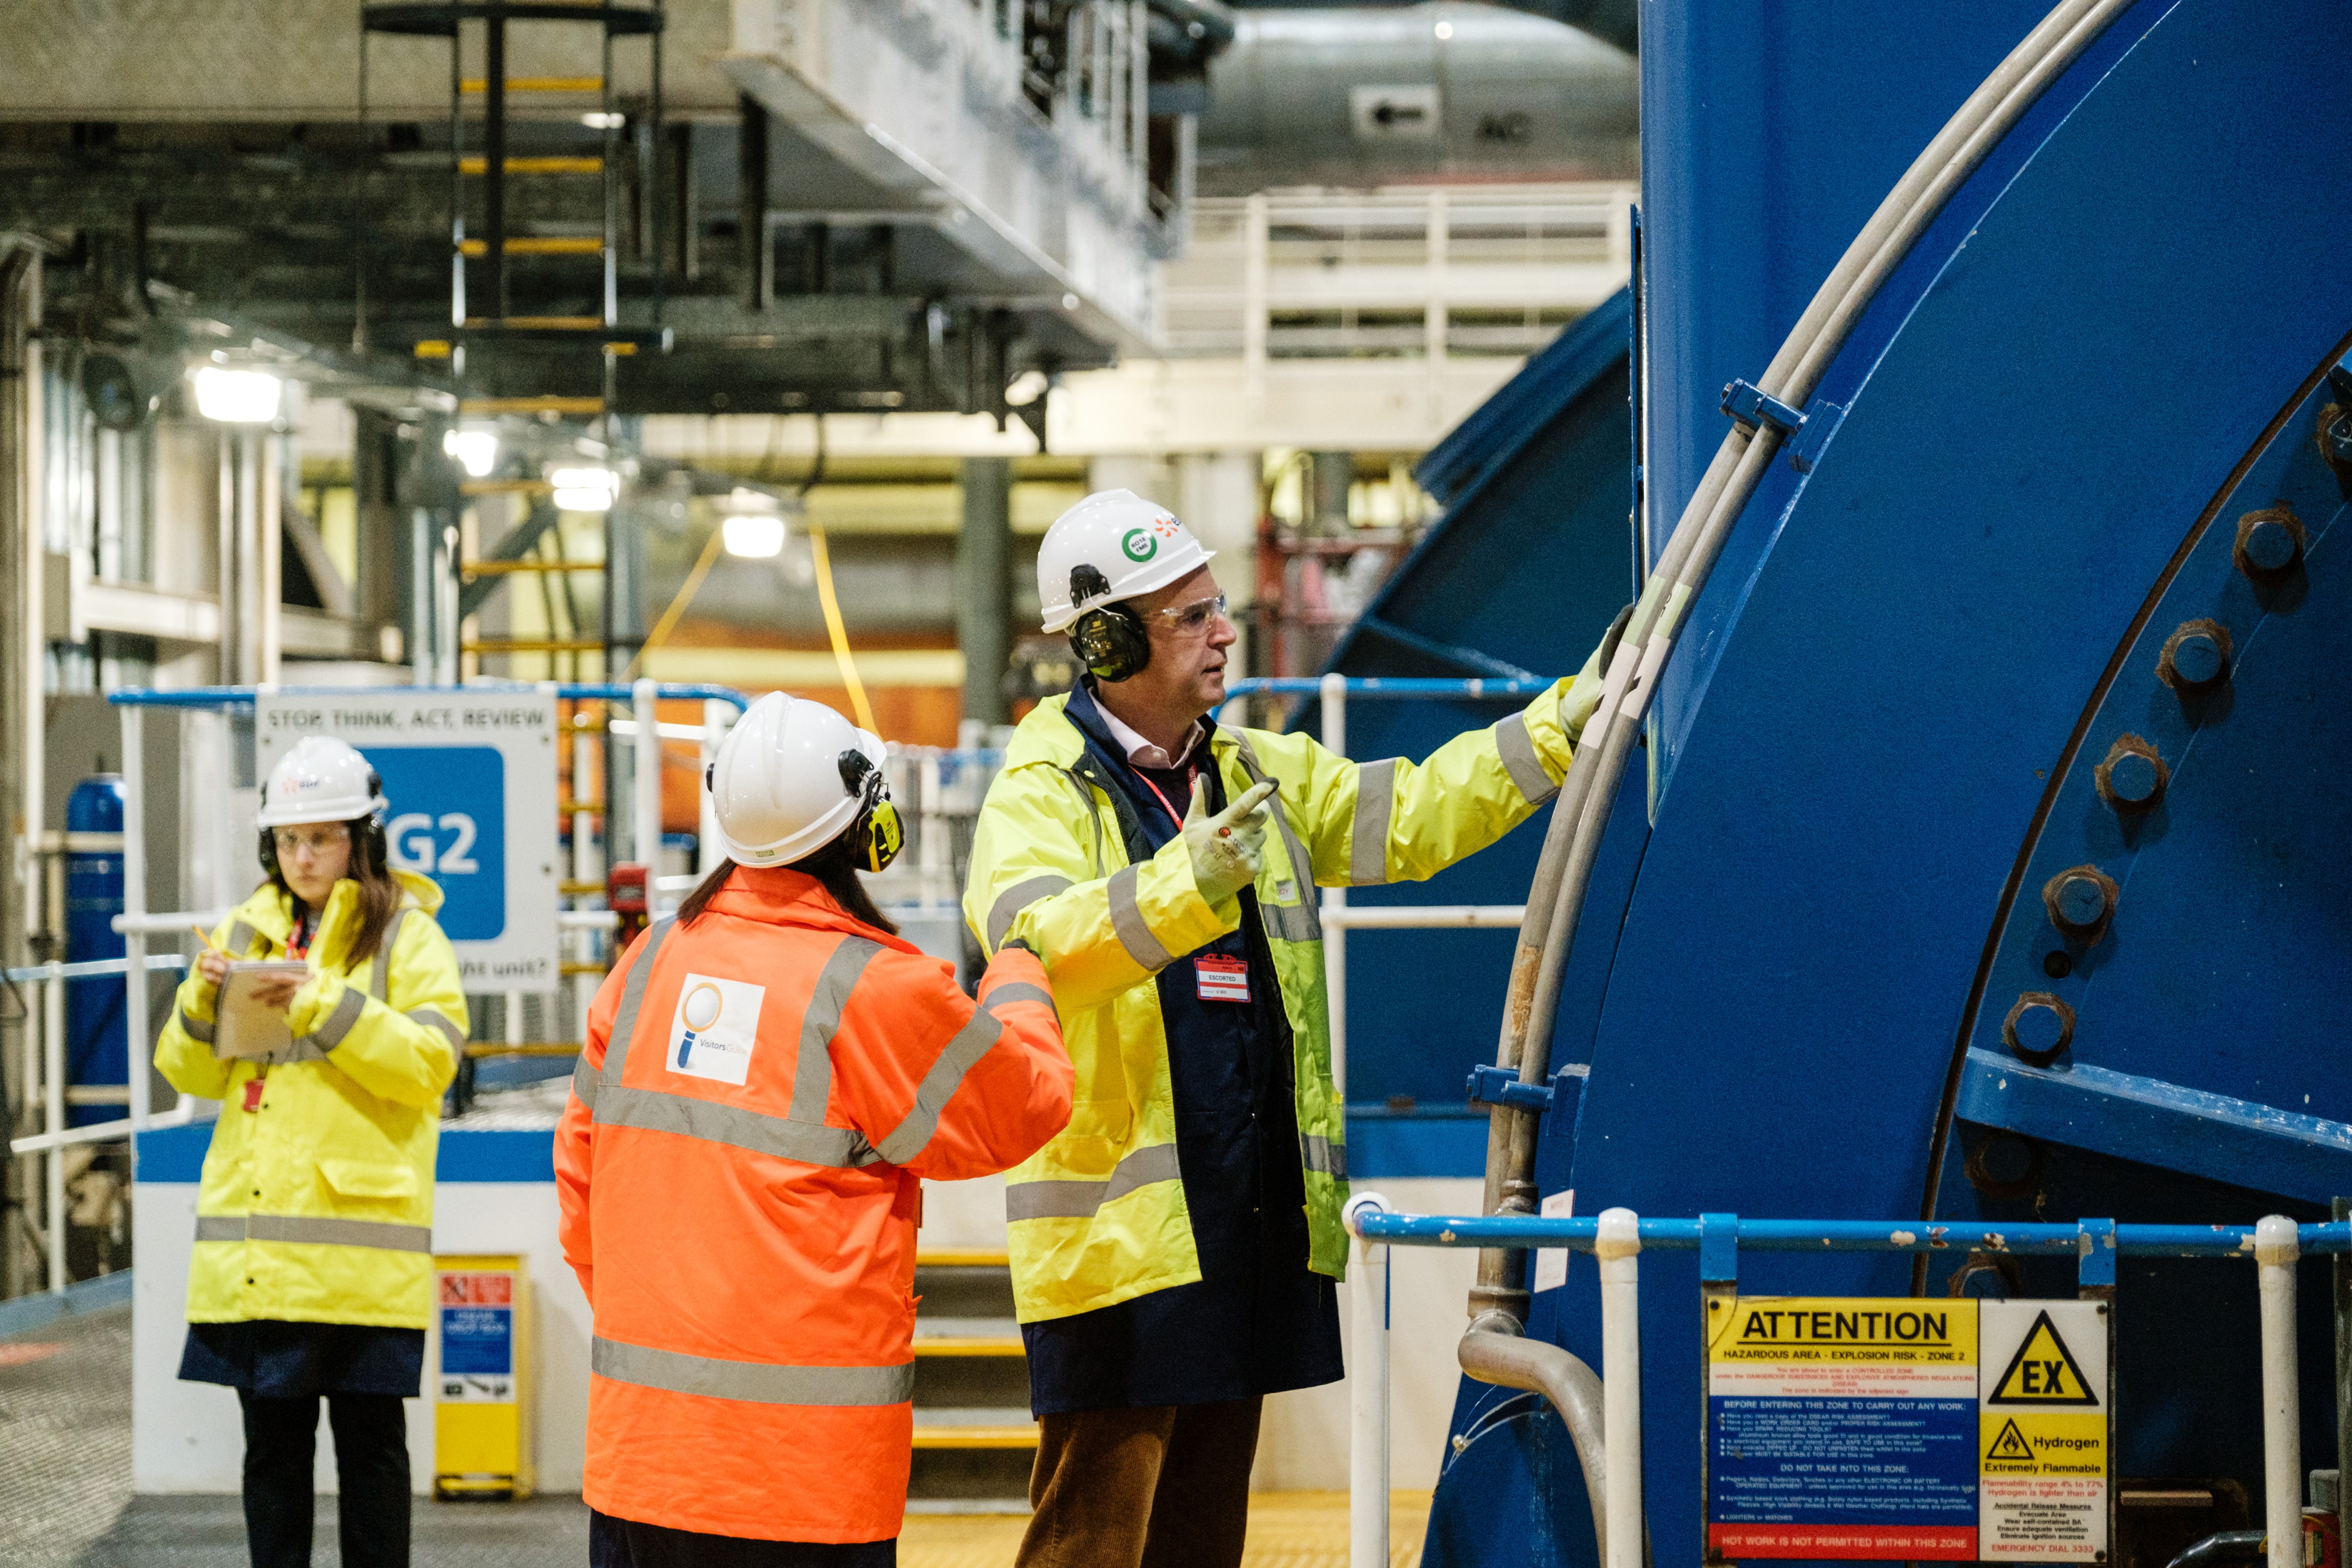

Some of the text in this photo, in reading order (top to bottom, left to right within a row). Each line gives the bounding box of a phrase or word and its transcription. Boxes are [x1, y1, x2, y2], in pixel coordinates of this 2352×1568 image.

[1136, 543, 1148, 552] FME
[462, 709, 544, 725] REVIEW
[386, 812, 479, 875] G2
[493, 957, 548, 976] unit?
[700, 1039, 726, 1051] Visitors
[1742, 1311, 1947, 1340] ATTENTION
[1724, 1351, 1789, 1359] HAZARDOUS
[1792, 1351, 1821, 1360] AREA
[1831, 1352, 1890, 1360] EXPLOSION
[1893, 1352, 1917, 1361] RISK
[1927, 1352, 1955, 1361] ZONE
[1958, 1353, 1965, 1361] 2
[2022, 1360, 2064, 1394] EX
[2034, 1437, 2099, 1452] Hydrogen
[1985, 1463, 2101, 1473] Extremely Flammable
[1982, 1480, 2032, 1488] Flammability
[1988, 1489, 2026, 1497] Hydrogen
[2040, 1489, 2064, 1498] lighter
[1722, 1536, 1967, 1548] HOT WORK IS NOT PERMITTED WITHIN THIS ZONE
